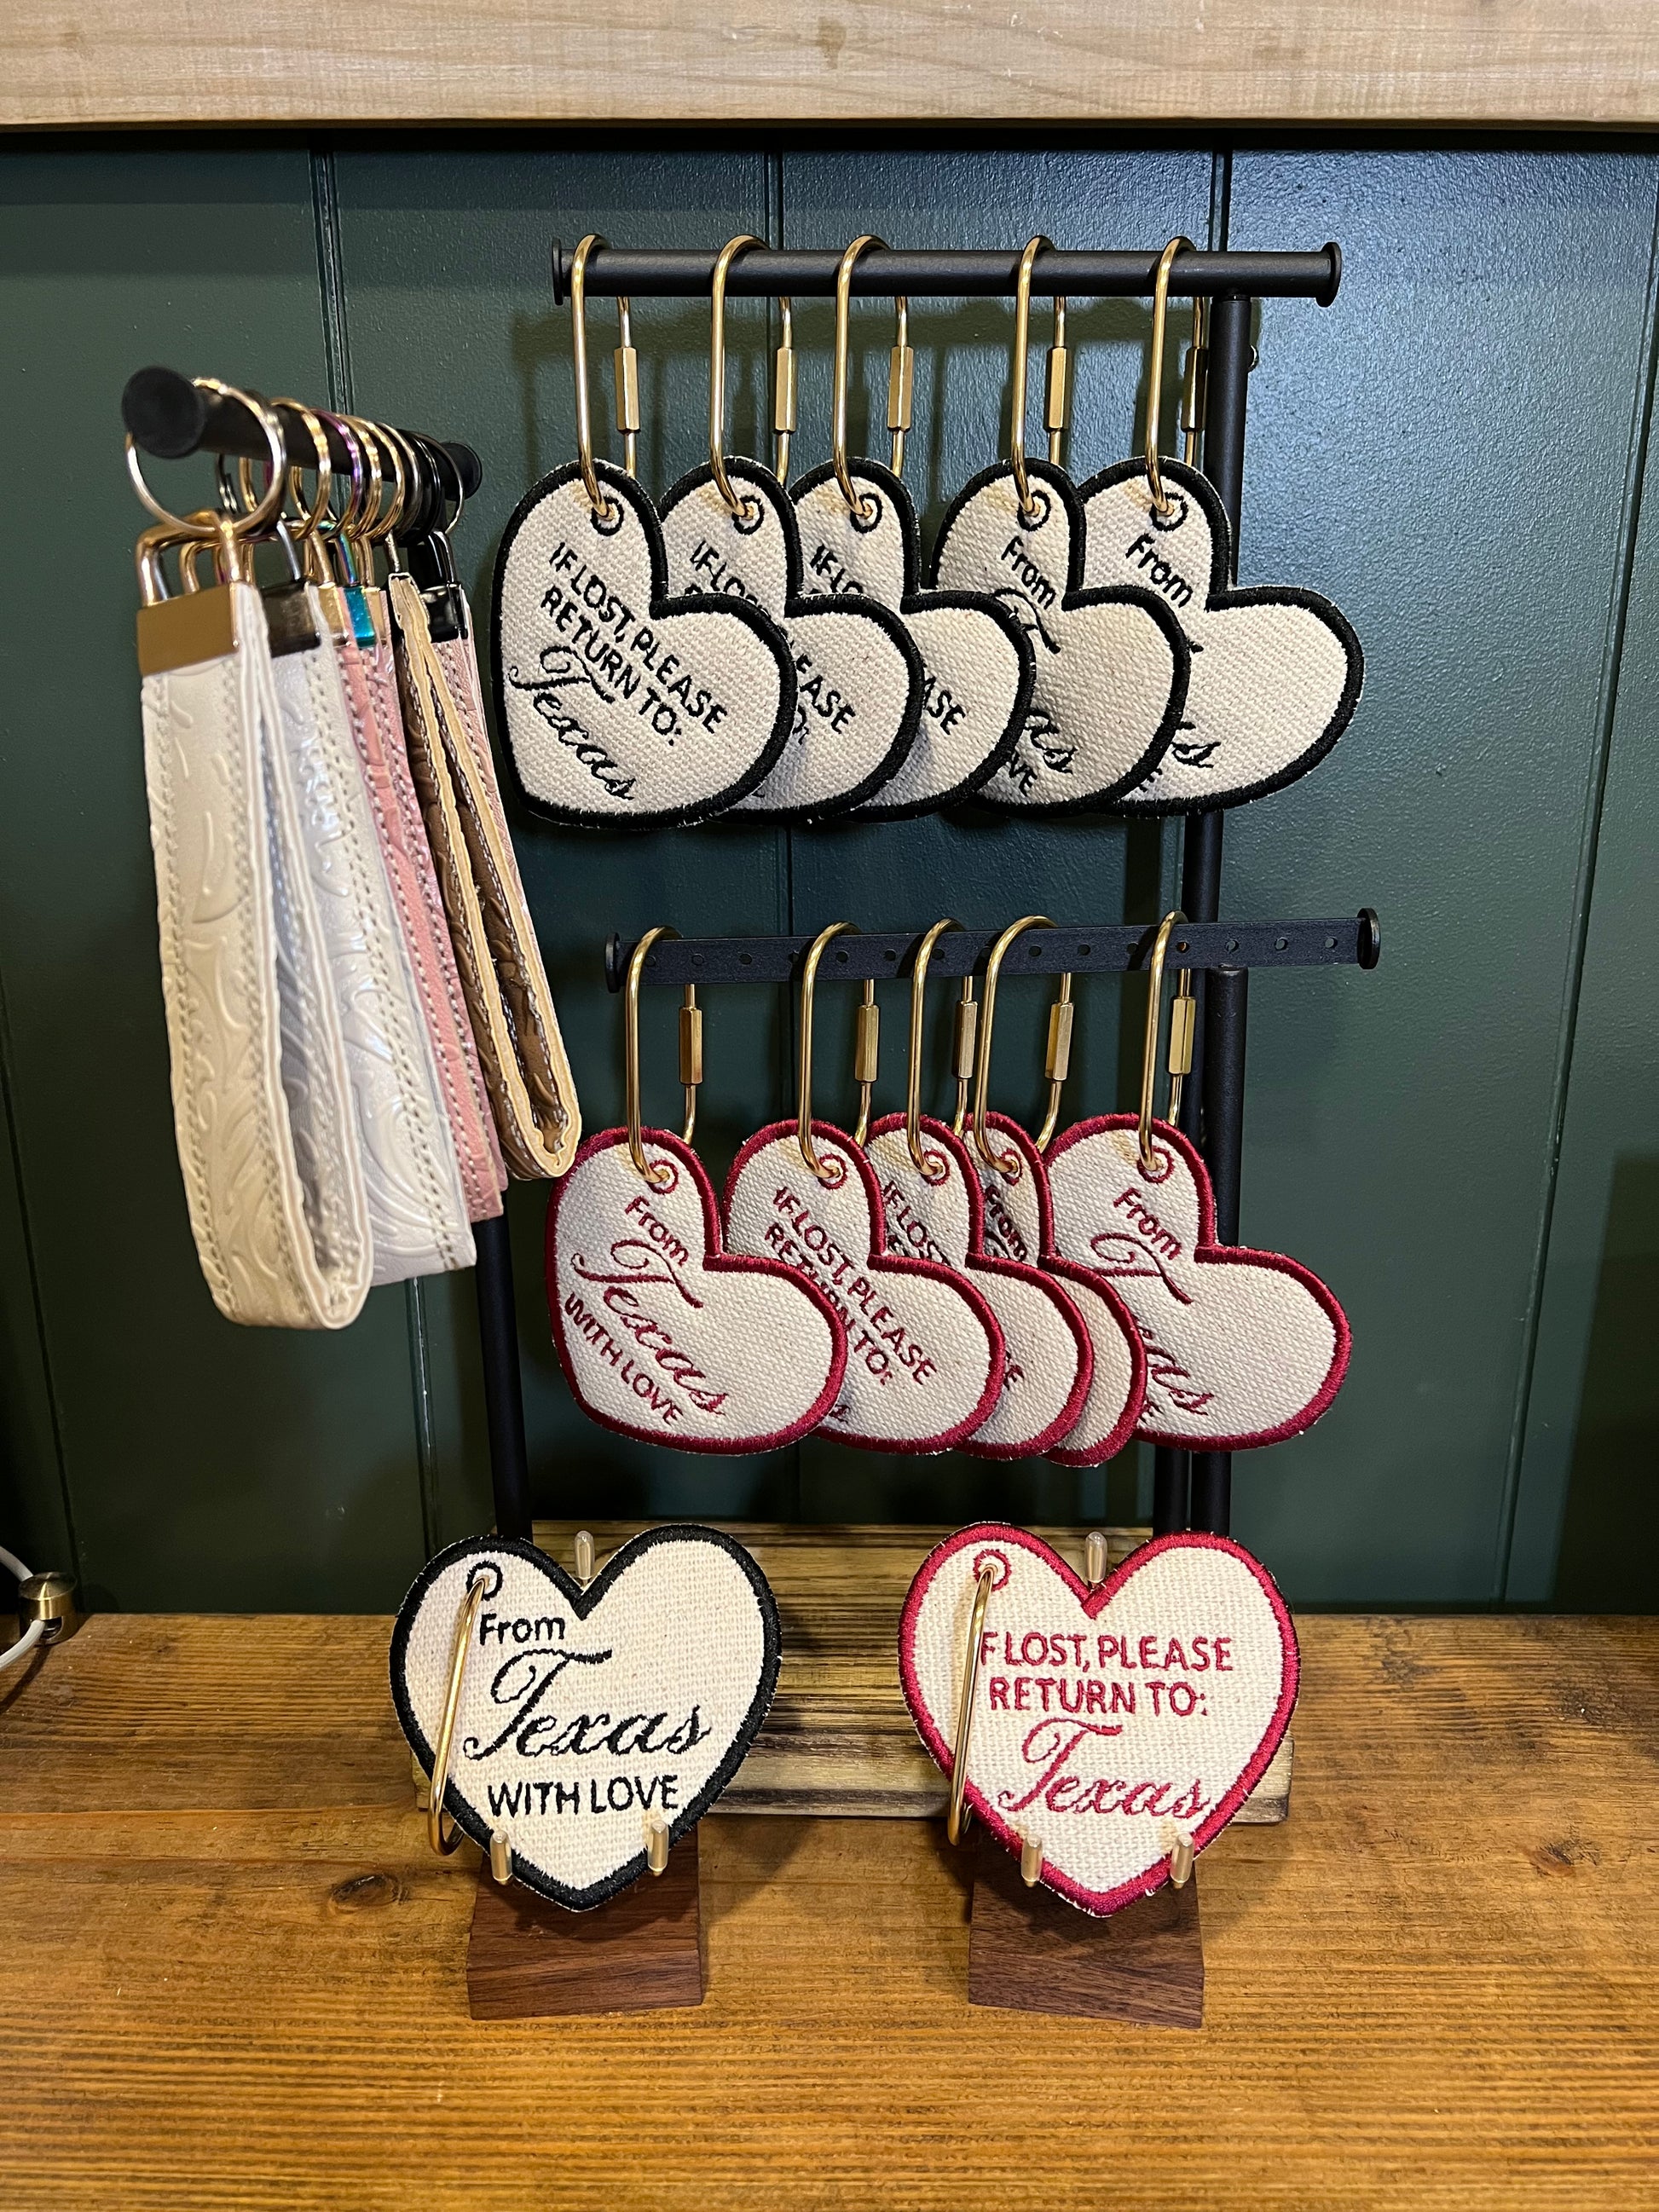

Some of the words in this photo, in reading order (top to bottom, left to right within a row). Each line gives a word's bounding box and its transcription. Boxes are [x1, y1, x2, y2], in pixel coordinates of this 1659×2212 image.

[690, 540, 720, 571] IF
[810, 544, 839, 575] IF
[1001, 535, 1056, 609] From
[1125, 533, 1194, 609] From
[540, 586, 642, 700] RETURN
[639, 687, 683, 747] TO:
[549, 542, 578, 572] IF
[570, 565, 635, 643] LOST,
[630, 627, 727, 734] PLEASE
[506, 645, 636, 801] Texas
[625, 1195, 690, 1267] From
[1113, 1187, 1182, 1260] From
[773, 1186, 801, 1215] IF
[791, 1210, 856, 1285] LOST,
[847, 1276, 938, 1385] PLEASE
[564, 1292, 623, 1366] WITH
[621, 1360, 684, 1425] LOVE
[570, 1239, 729, 1416] Texas
[854, 1330, 893, 1385] TO:
[479, 1613, 566, 1647] From
[1004, 1631, 1090, 1673] LOST,
[1097, 1633, 1234, 1672] PLEASE
[463, 1649, 712, 1762] Texas
[989, 1676, 1136, 1716] RETURN
[1145, 1680, 1209, 1718] TO:
[488, 1780, 580, 1818] WITH
[591, 1775, 679, 1813] LOVE
[998, 1717, 1212, 1819] Texas
